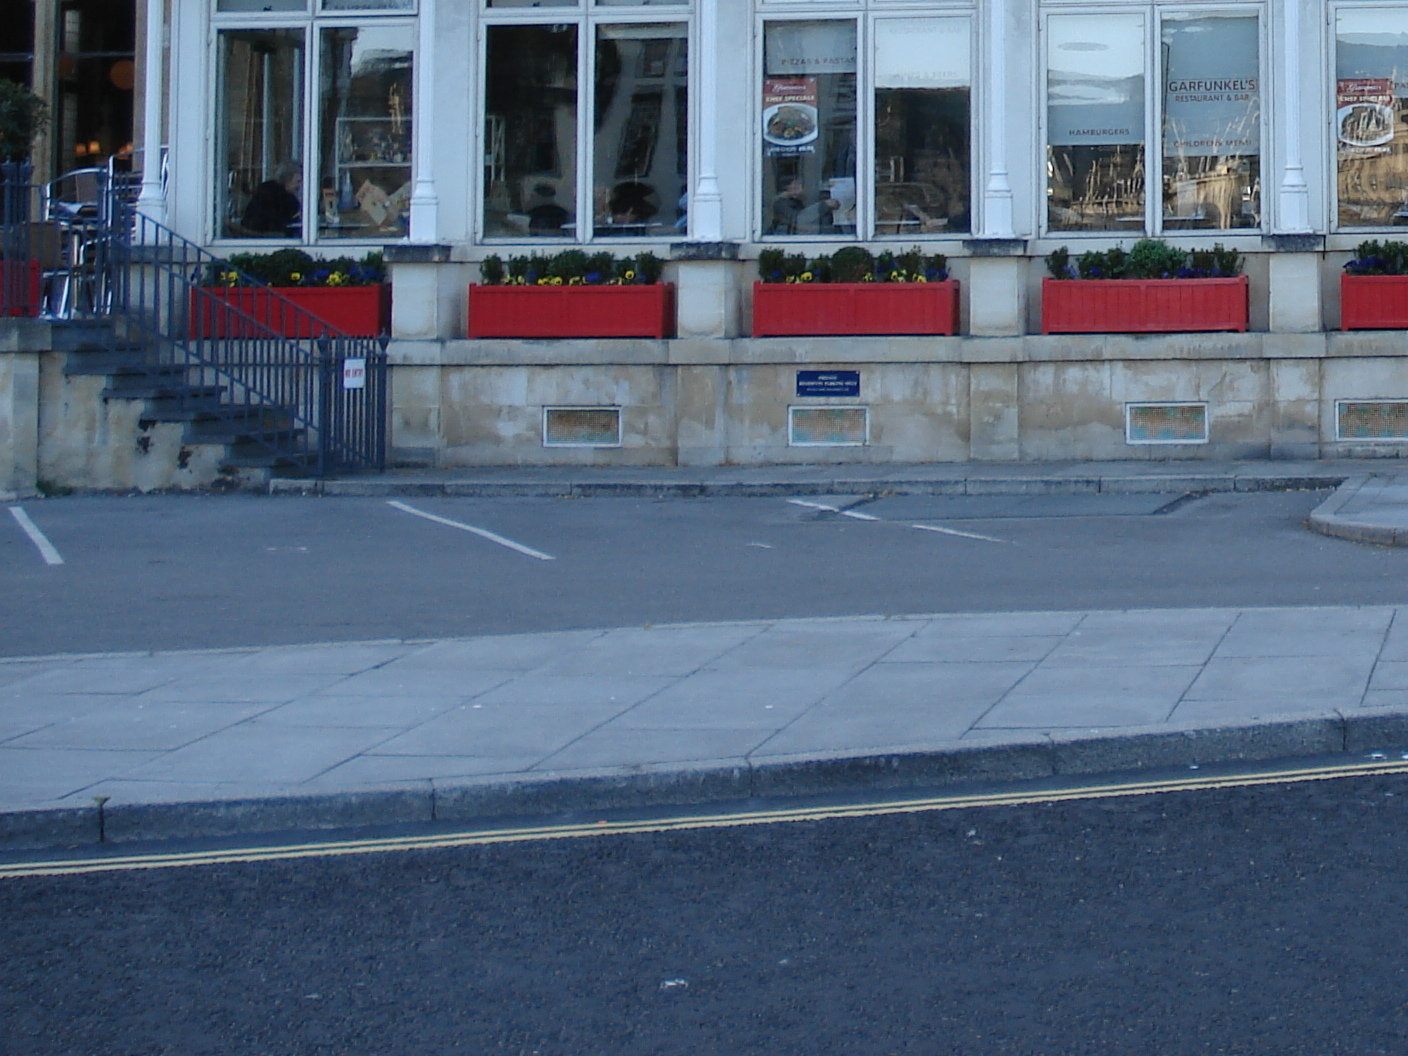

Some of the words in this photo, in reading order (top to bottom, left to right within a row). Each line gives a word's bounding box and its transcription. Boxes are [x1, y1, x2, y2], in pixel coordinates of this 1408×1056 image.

[1168, 79, 1256, 92] GARFUNKEL'S
[1175, 94, 1223, 103] RESTAURANT
[1226, 94, 1232, 102] &
[1234, 93, 1249, 101] BAR
[1068, 128, 1130, 136] HAMBURGERS
